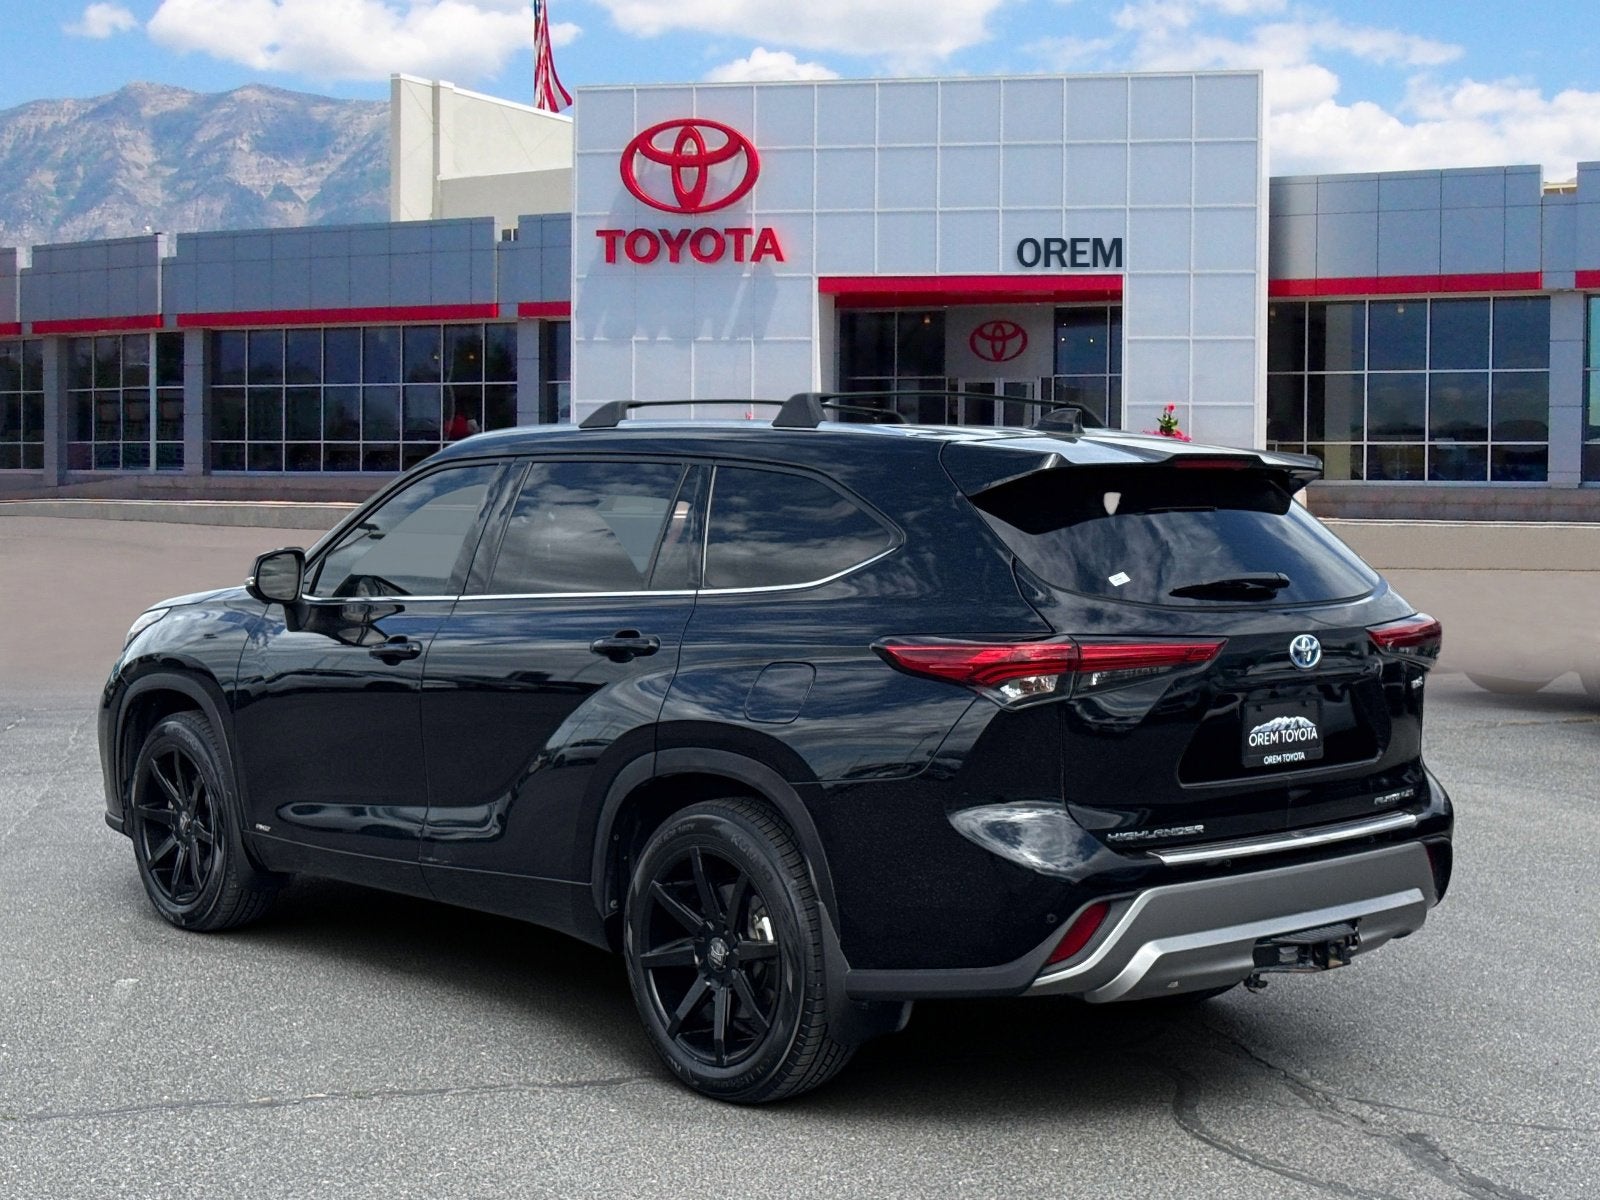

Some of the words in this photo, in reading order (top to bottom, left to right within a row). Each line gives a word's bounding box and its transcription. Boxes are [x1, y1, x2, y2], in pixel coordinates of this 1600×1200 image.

[596, 227, 785, 265] TOYOTA
[1016, 237, 1123, 268] OREM
[1248, 731, 1279, 747] OREM
[1281, 727, 1318, 743] TOYOTA
[1263, 754, 1282, 765] OREM
[1282, 752, 1305, 763] TOYOTA
[1106, 824, 1205, 842] HIGHLANDER
[731, 833, 774, 883] KUMO
